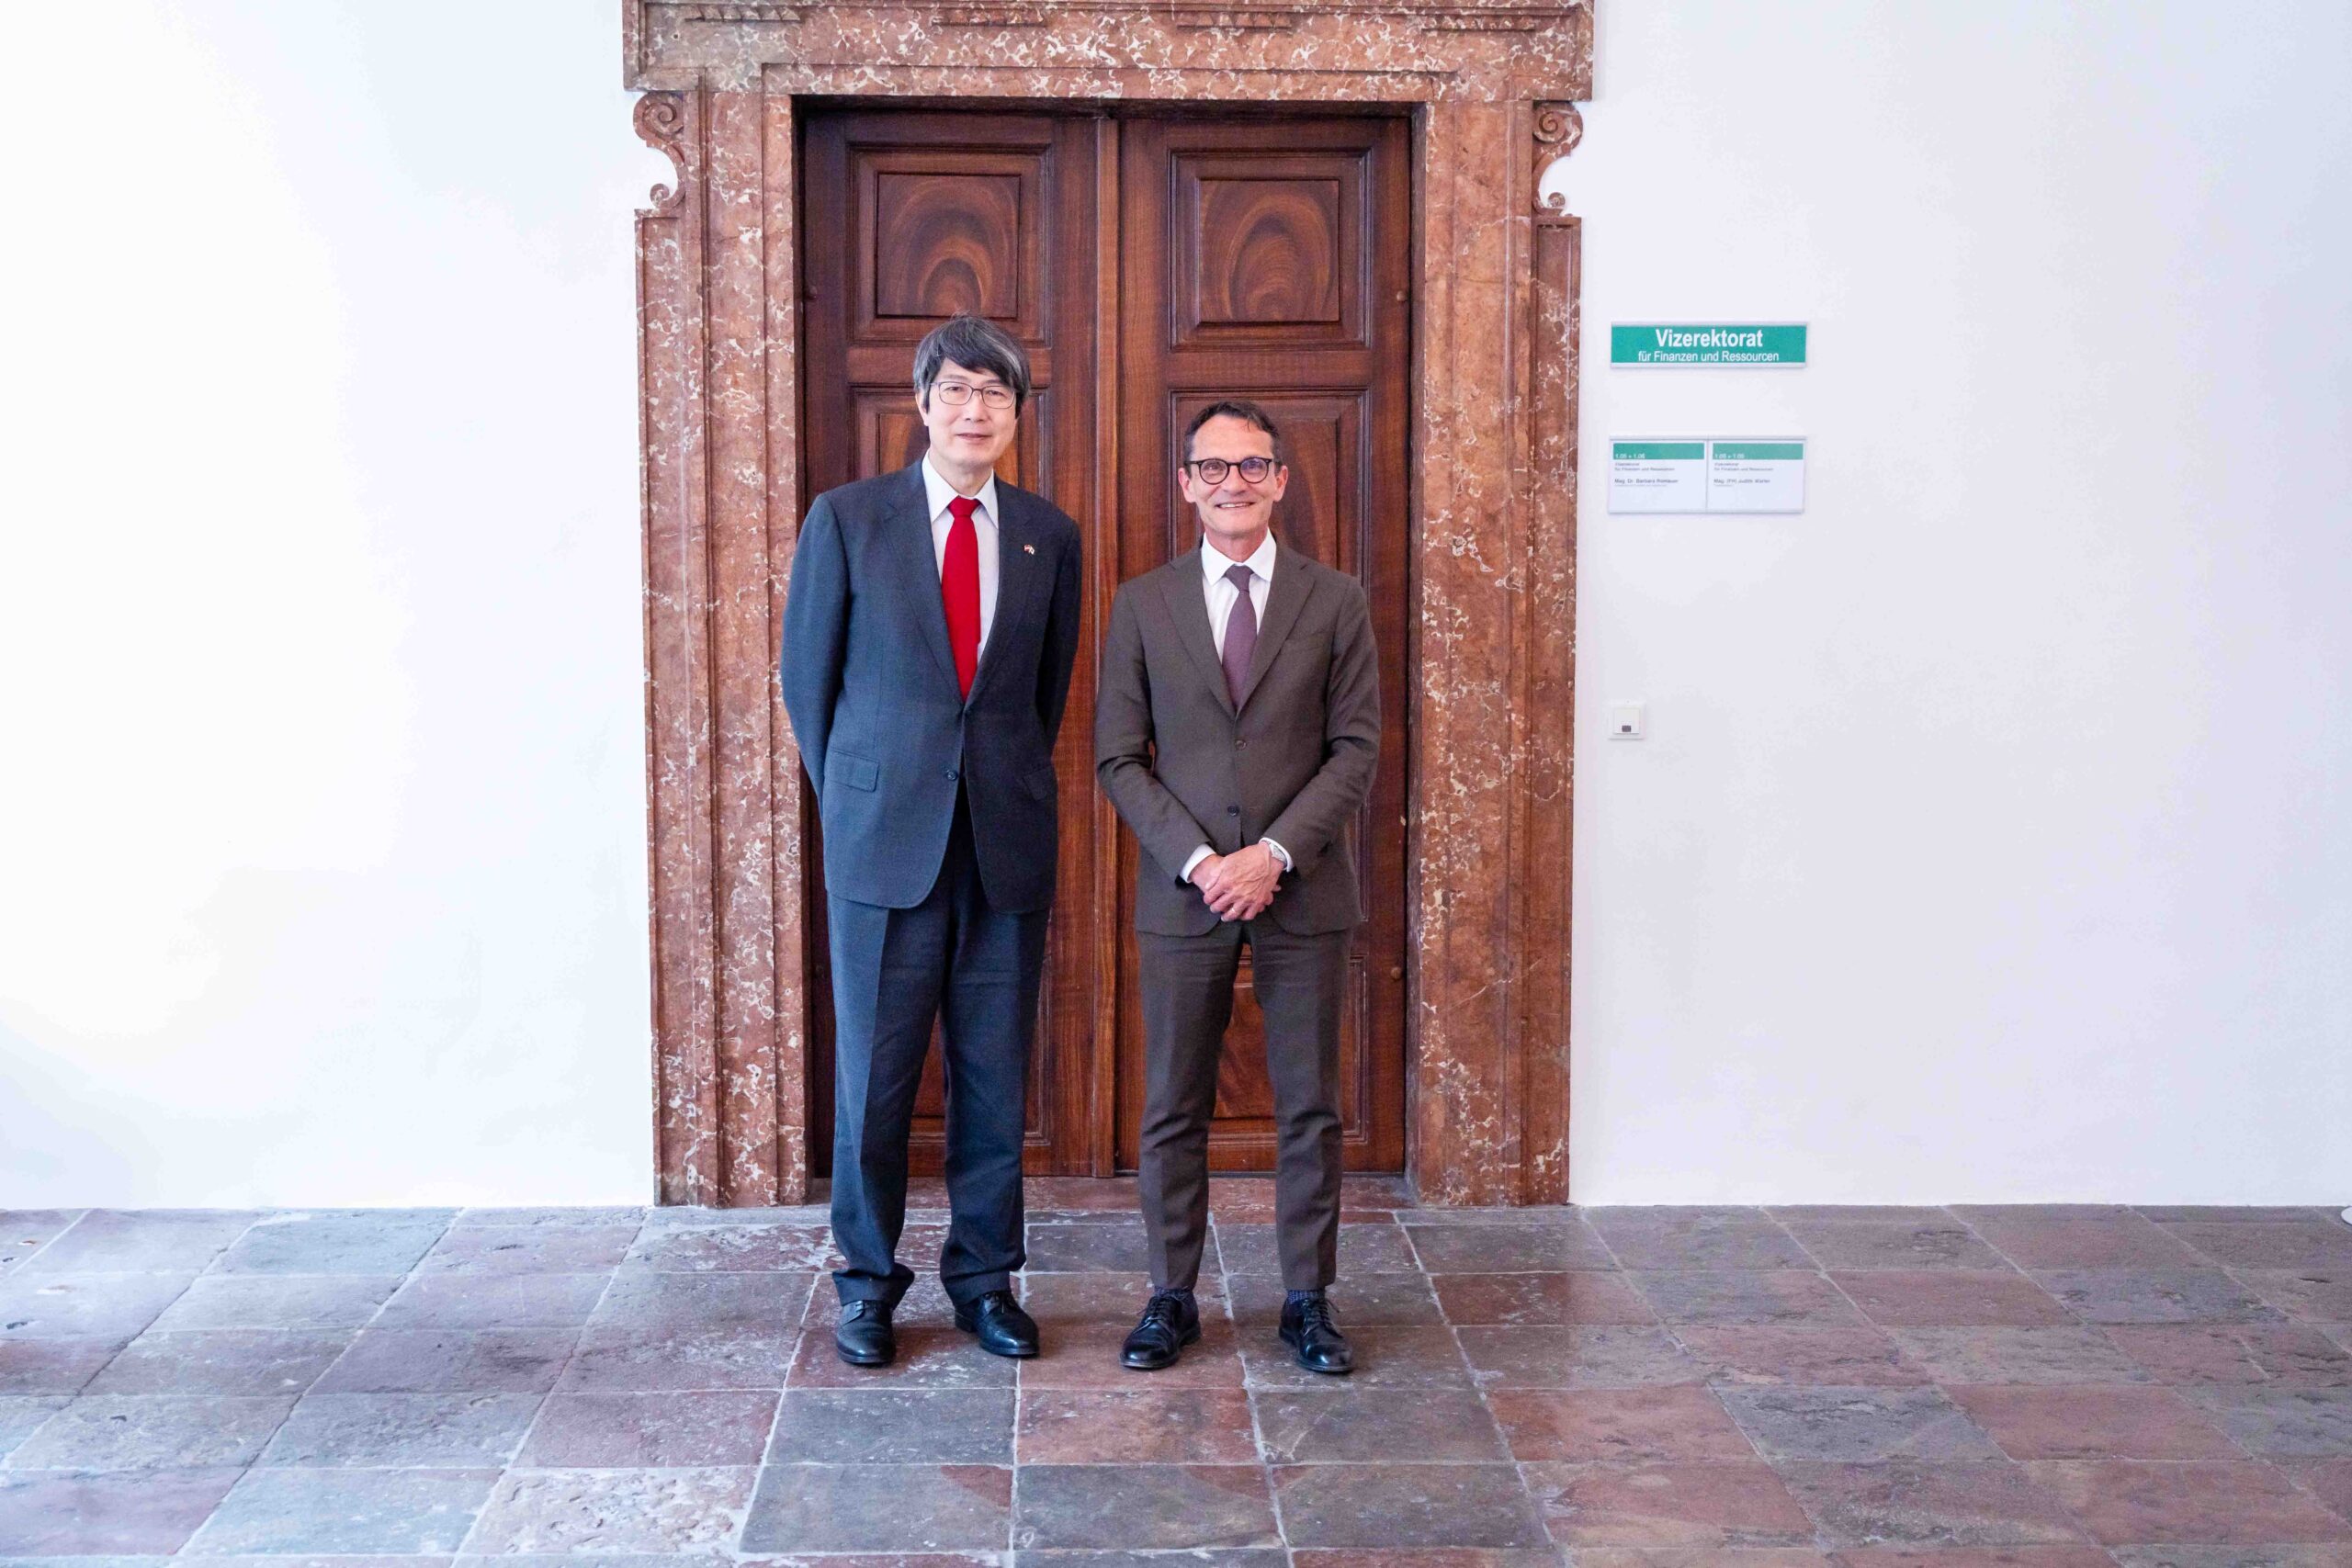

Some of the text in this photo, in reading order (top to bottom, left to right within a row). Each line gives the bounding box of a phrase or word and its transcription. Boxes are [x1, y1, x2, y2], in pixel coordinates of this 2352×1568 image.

[1655, 329, 1763, 347] Vizerektorat
[1638, 350, 1780, 362] für Finanzen und Ressourcen
